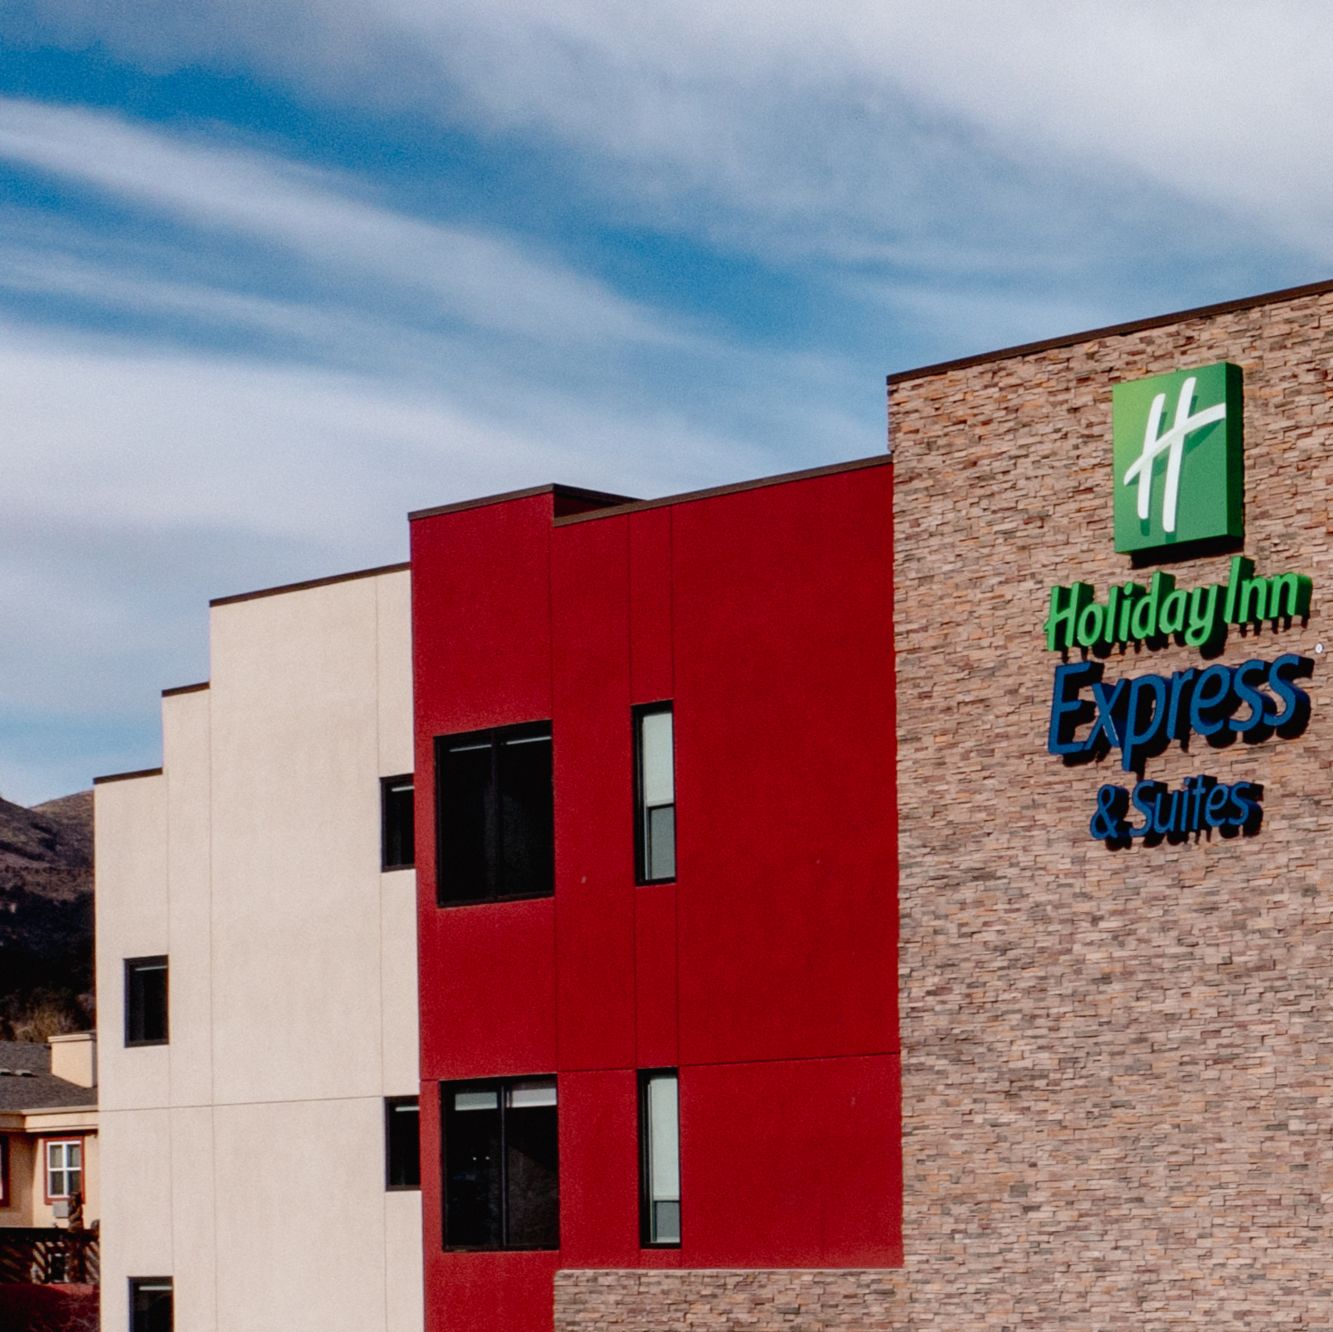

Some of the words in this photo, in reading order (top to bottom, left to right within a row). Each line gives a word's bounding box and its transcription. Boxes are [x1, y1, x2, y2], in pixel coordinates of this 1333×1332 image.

[1045, 571, 1222, 648] Holiday
[1224, 556, 1306, 626] Inn
[1047, 654, 1307, 773] Express
[1090, 784, 1124, 840] &
[1129, 775, 1256, 839] Suites
